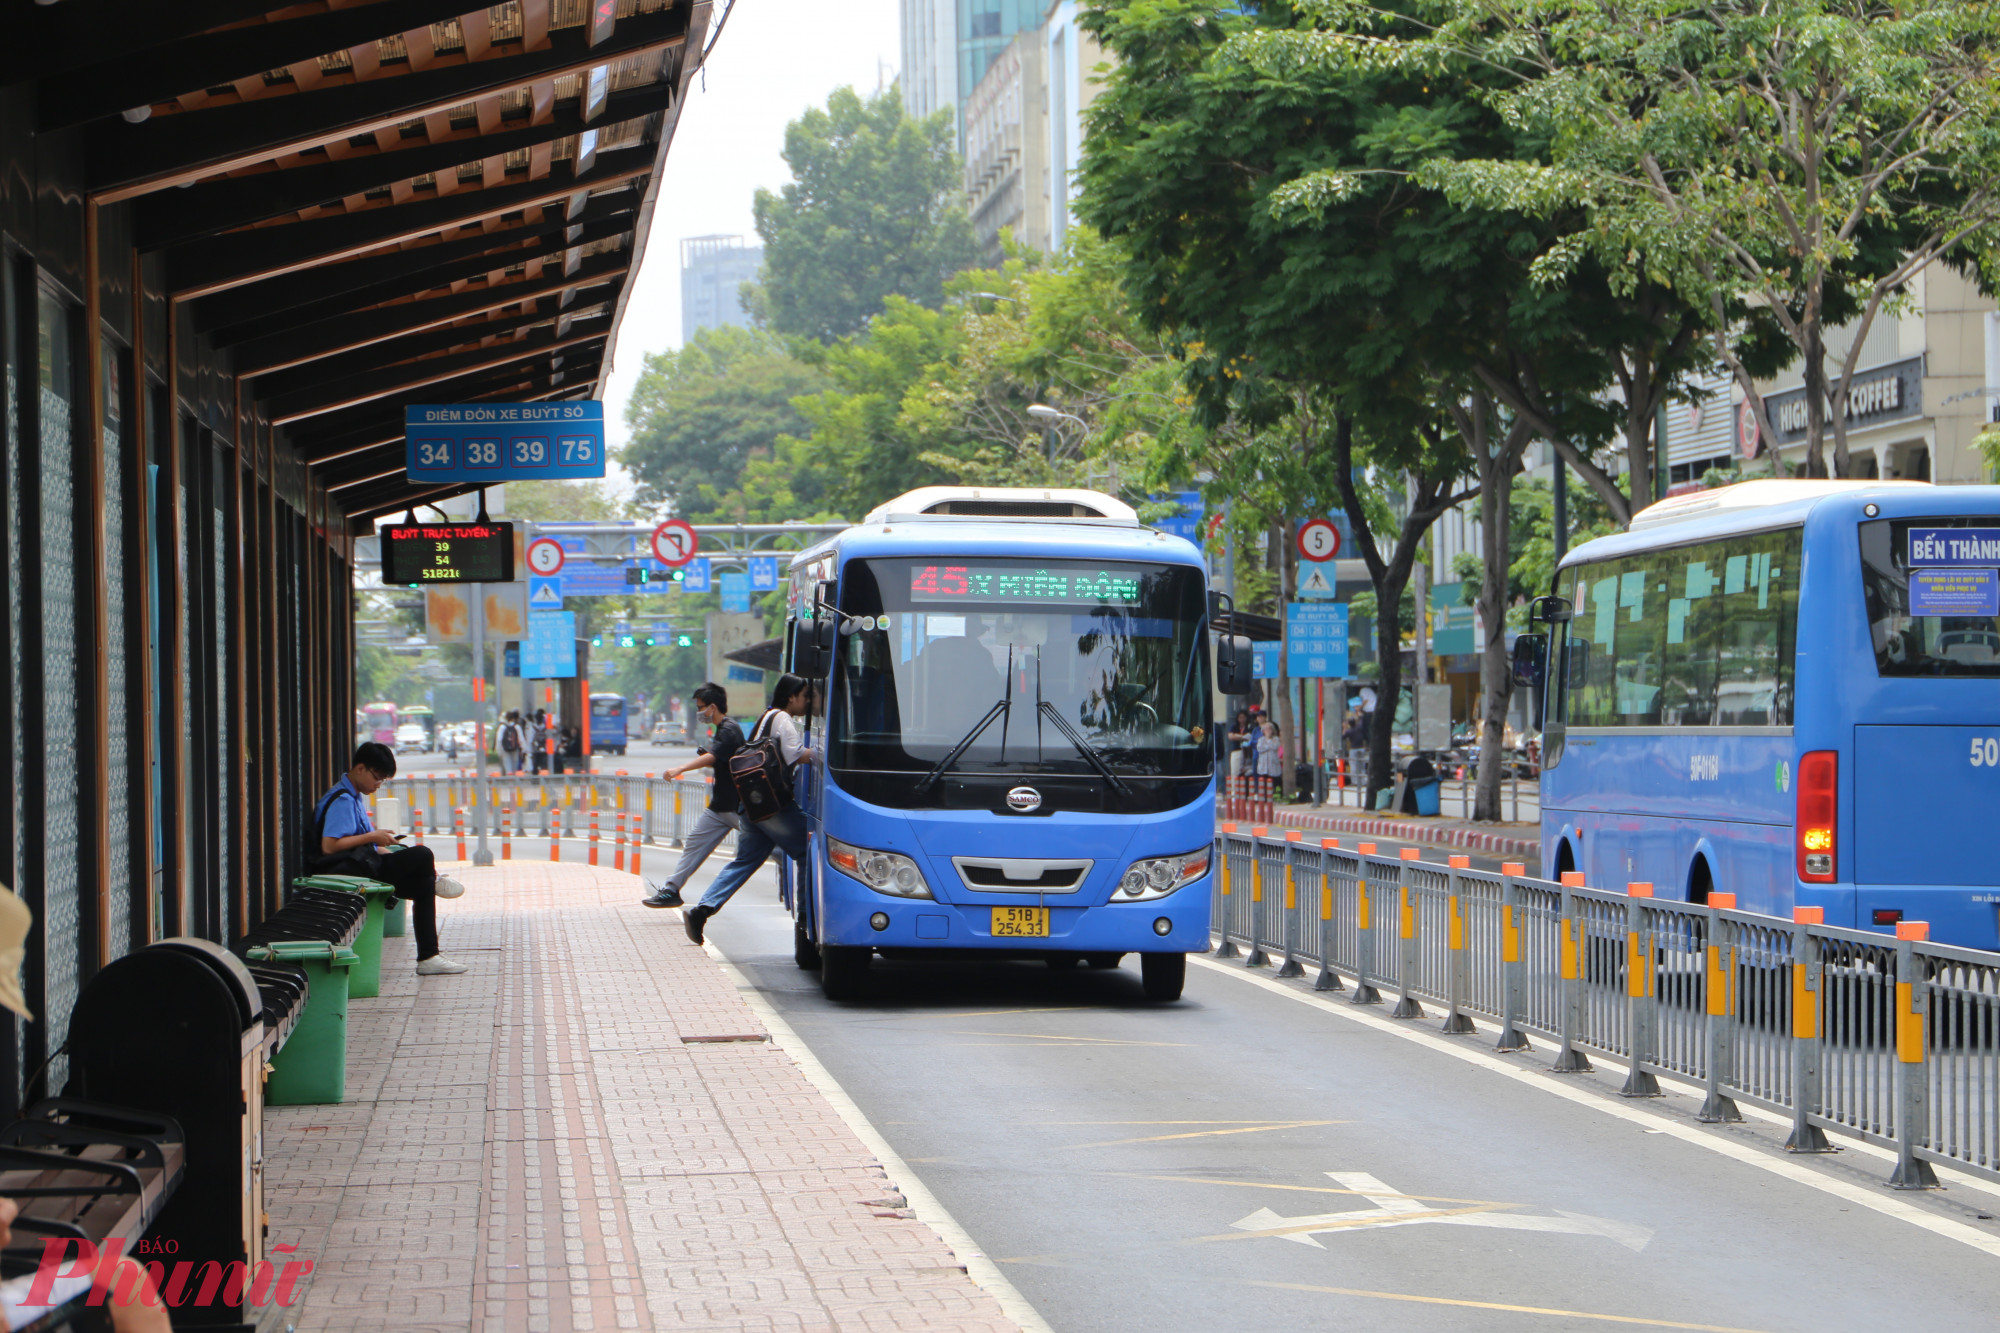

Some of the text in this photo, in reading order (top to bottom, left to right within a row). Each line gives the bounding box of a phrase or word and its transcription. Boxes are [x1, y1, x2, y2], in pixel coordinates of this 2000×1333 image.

[1851, 376, 1899, 416] COFFEE
[500, 409, 518, 419] XE
[522, 405, 560, 419] BUÝT
[564, 405, 584, 418] SỐ
[420, 440, 591, 465] 34 38 39 75
[435, 542, 450, 552] 39
[1314, 531, 1323, 549] 5
[1913, 533, 2000, 559] BẾN THÀNH
[435, 555, 450, 565] 54
[542, 549, 549, 565] 5
[912, 566, 968, 594] 45
[1970, 738, 2000, 767] 50
[1009, 795, 1040, 804] SAMCO
[1007, 908, 1033, 922] 51B
[997, 922, 1043, 936] 254.33
